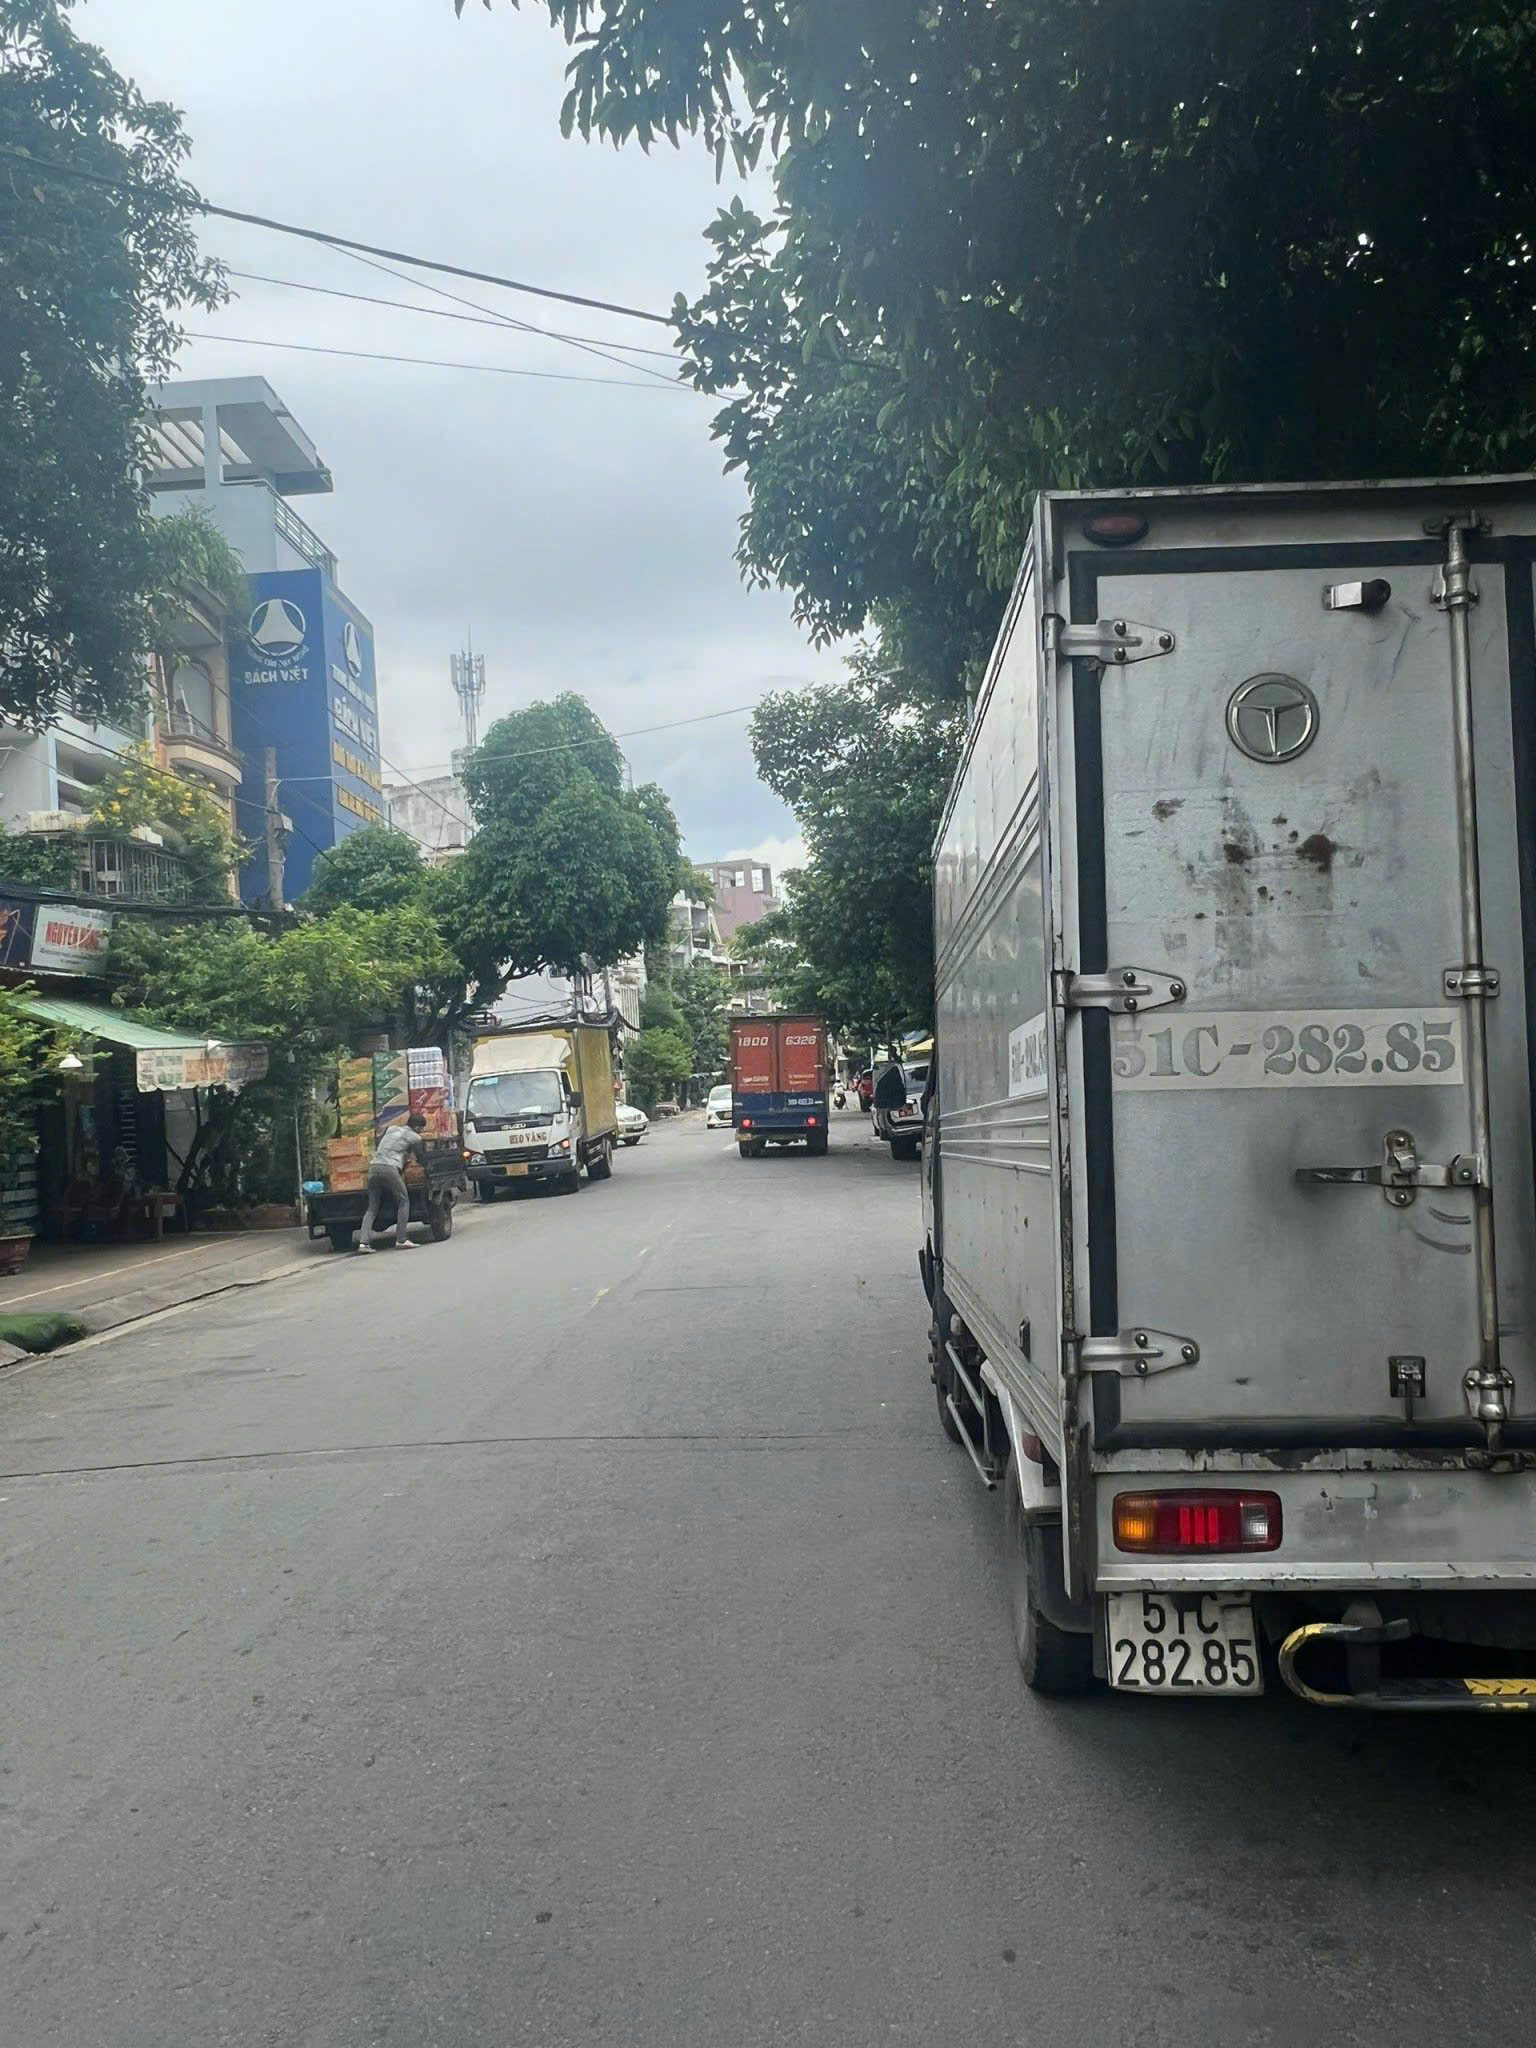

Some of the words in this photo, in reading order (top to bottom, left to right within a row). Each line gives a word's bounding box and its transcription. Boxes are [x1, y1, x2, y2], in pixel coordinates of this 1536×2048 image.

[738, 1036, 769, 1047] 1800
[1114, 1021, 1456, 1079] 51C-282.85
[501, 1123, 527, 1131] ISUZU
[1115, 1638, 1255, 1687] 282.85
